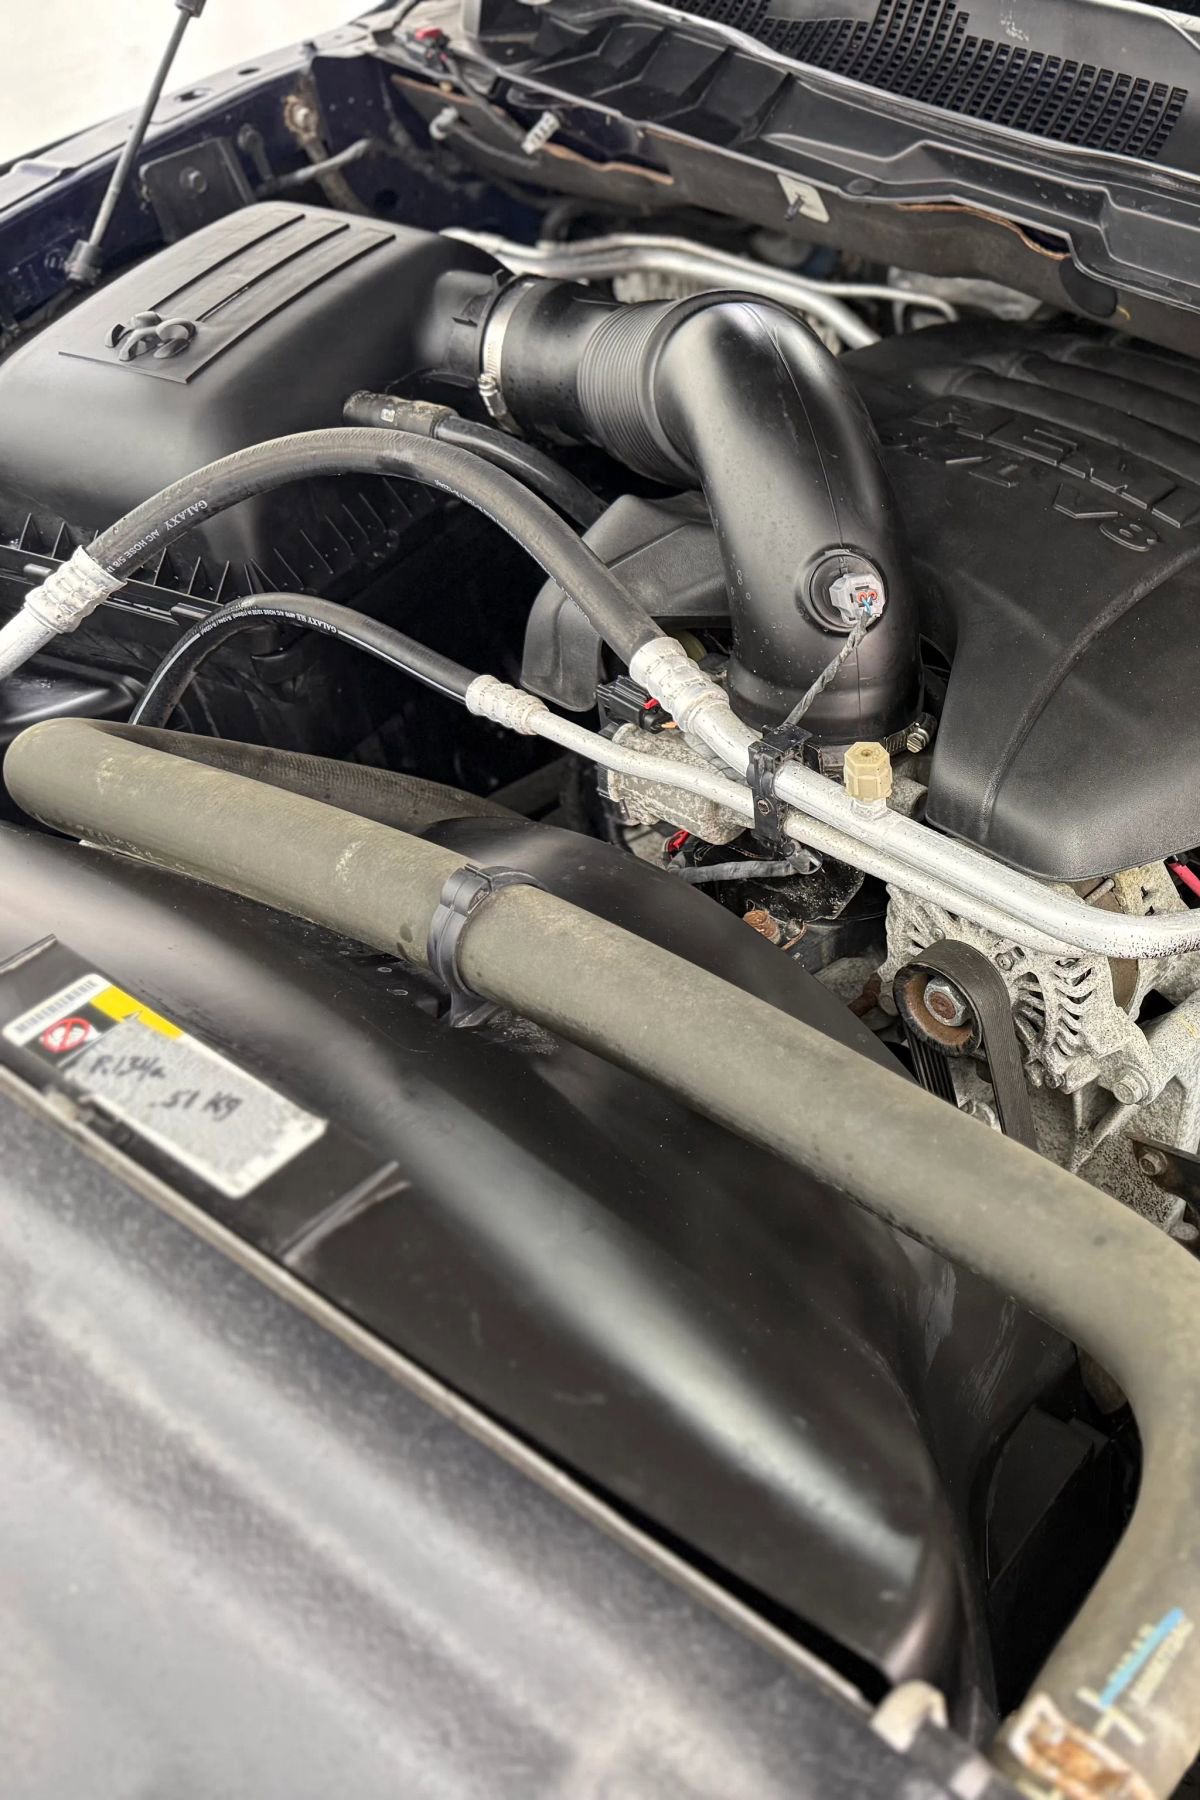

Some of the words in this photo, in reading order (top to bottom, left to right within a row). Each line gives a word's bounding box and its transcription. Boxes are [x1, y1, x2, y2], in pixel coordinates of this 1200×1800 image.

[162, 498, 209, 532] GALAXY
[1051, 483, 1160, 553] V8
[122, 538, 147, 559] HOSE
[111, 554, 126, 568] 5/8
[306, 616, 336, 633] GALAXY
